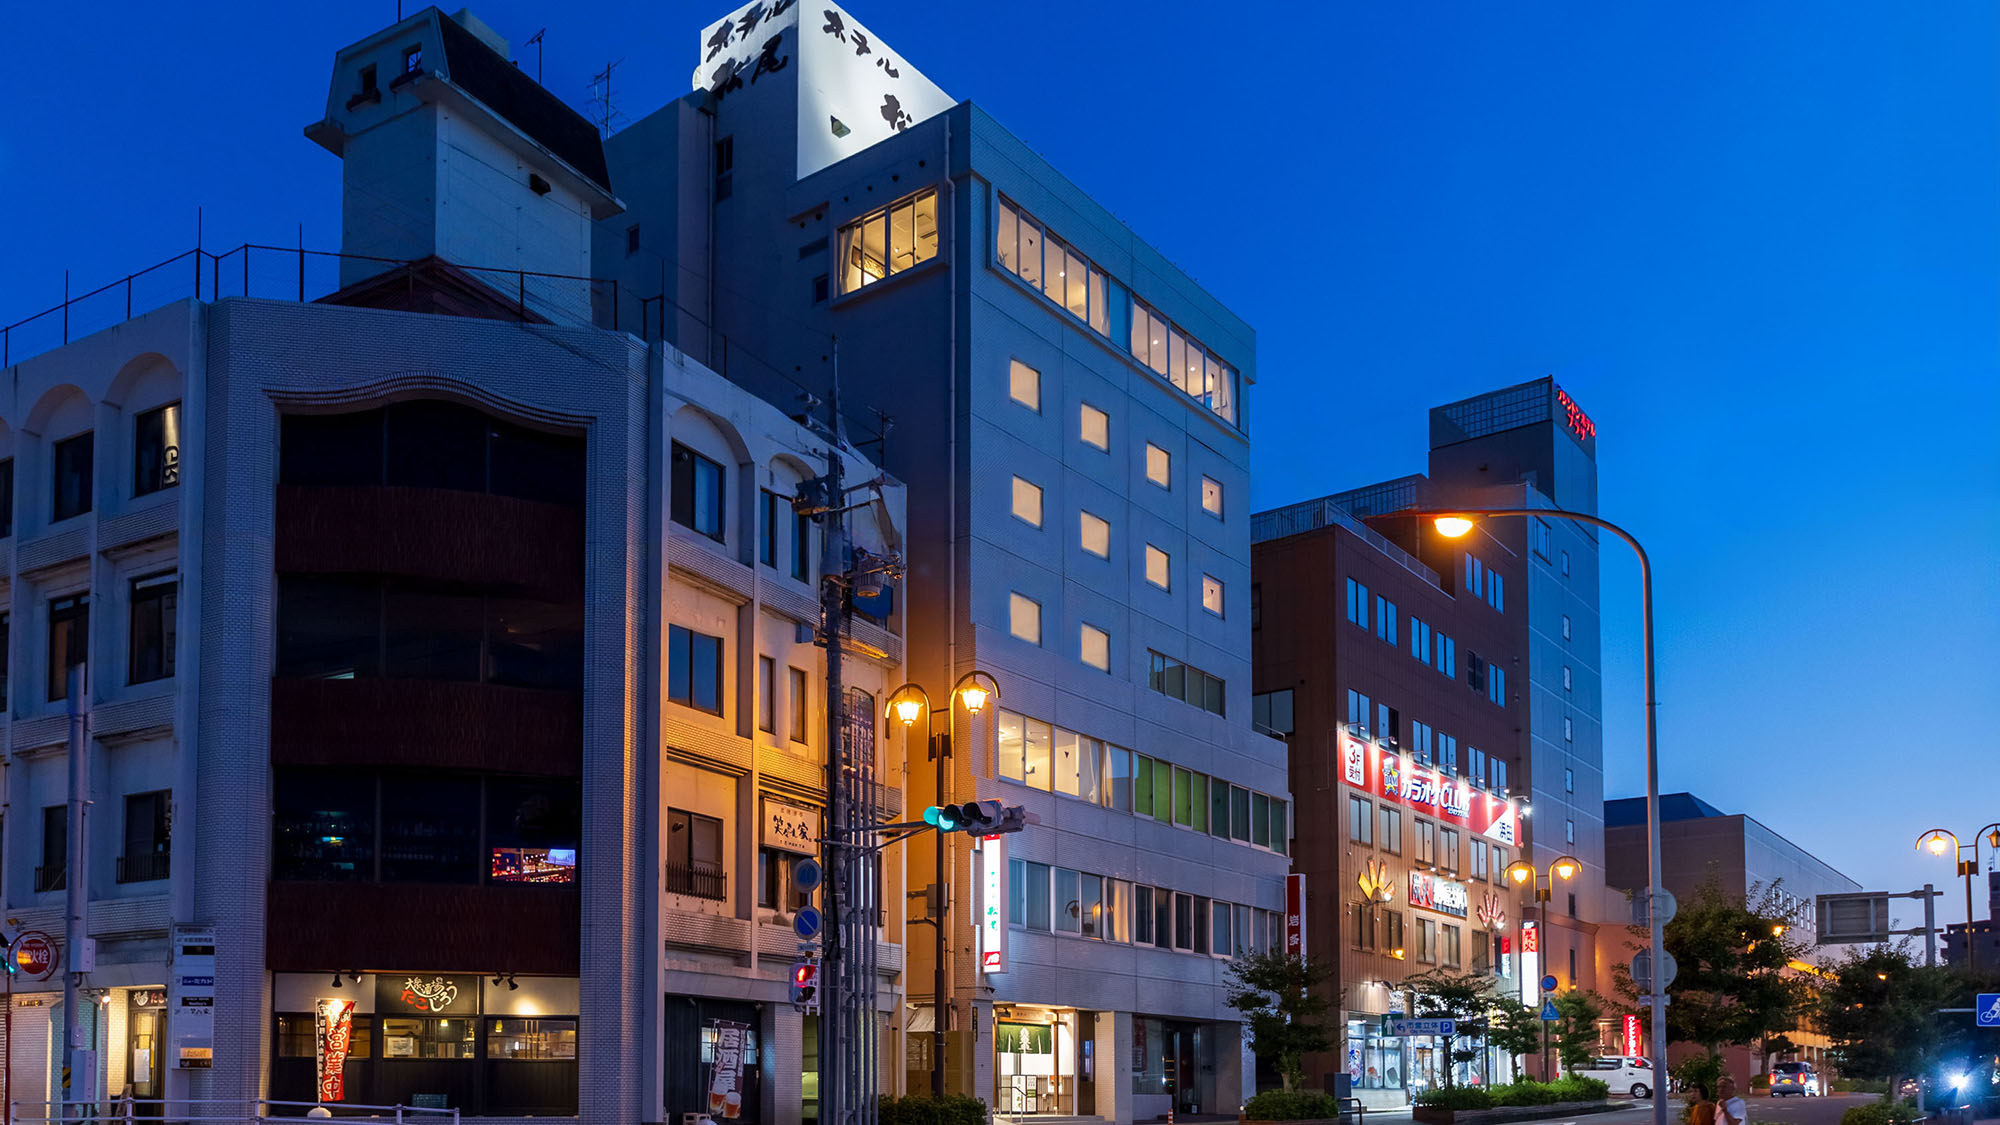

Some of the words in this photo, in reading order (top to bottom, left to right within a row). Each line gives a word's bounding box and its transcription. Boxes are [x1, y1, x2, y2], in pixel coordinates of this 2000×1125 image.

[706, 0, 797, 62] ホテル
[823, 9, 899, 78] ホテル
[1349, 744, 1361, 765] 3F
[1349, 765, 1361, 782] 受付
[1525, 930, 1536, 952] 炭火
[401, 981, 458, 1012] たこじろう
[404, 977, 445, 998] 大衆酒場
[1443, 1023, 1450, 1032] P
[322, 1026, 347, 1099] 営業中
